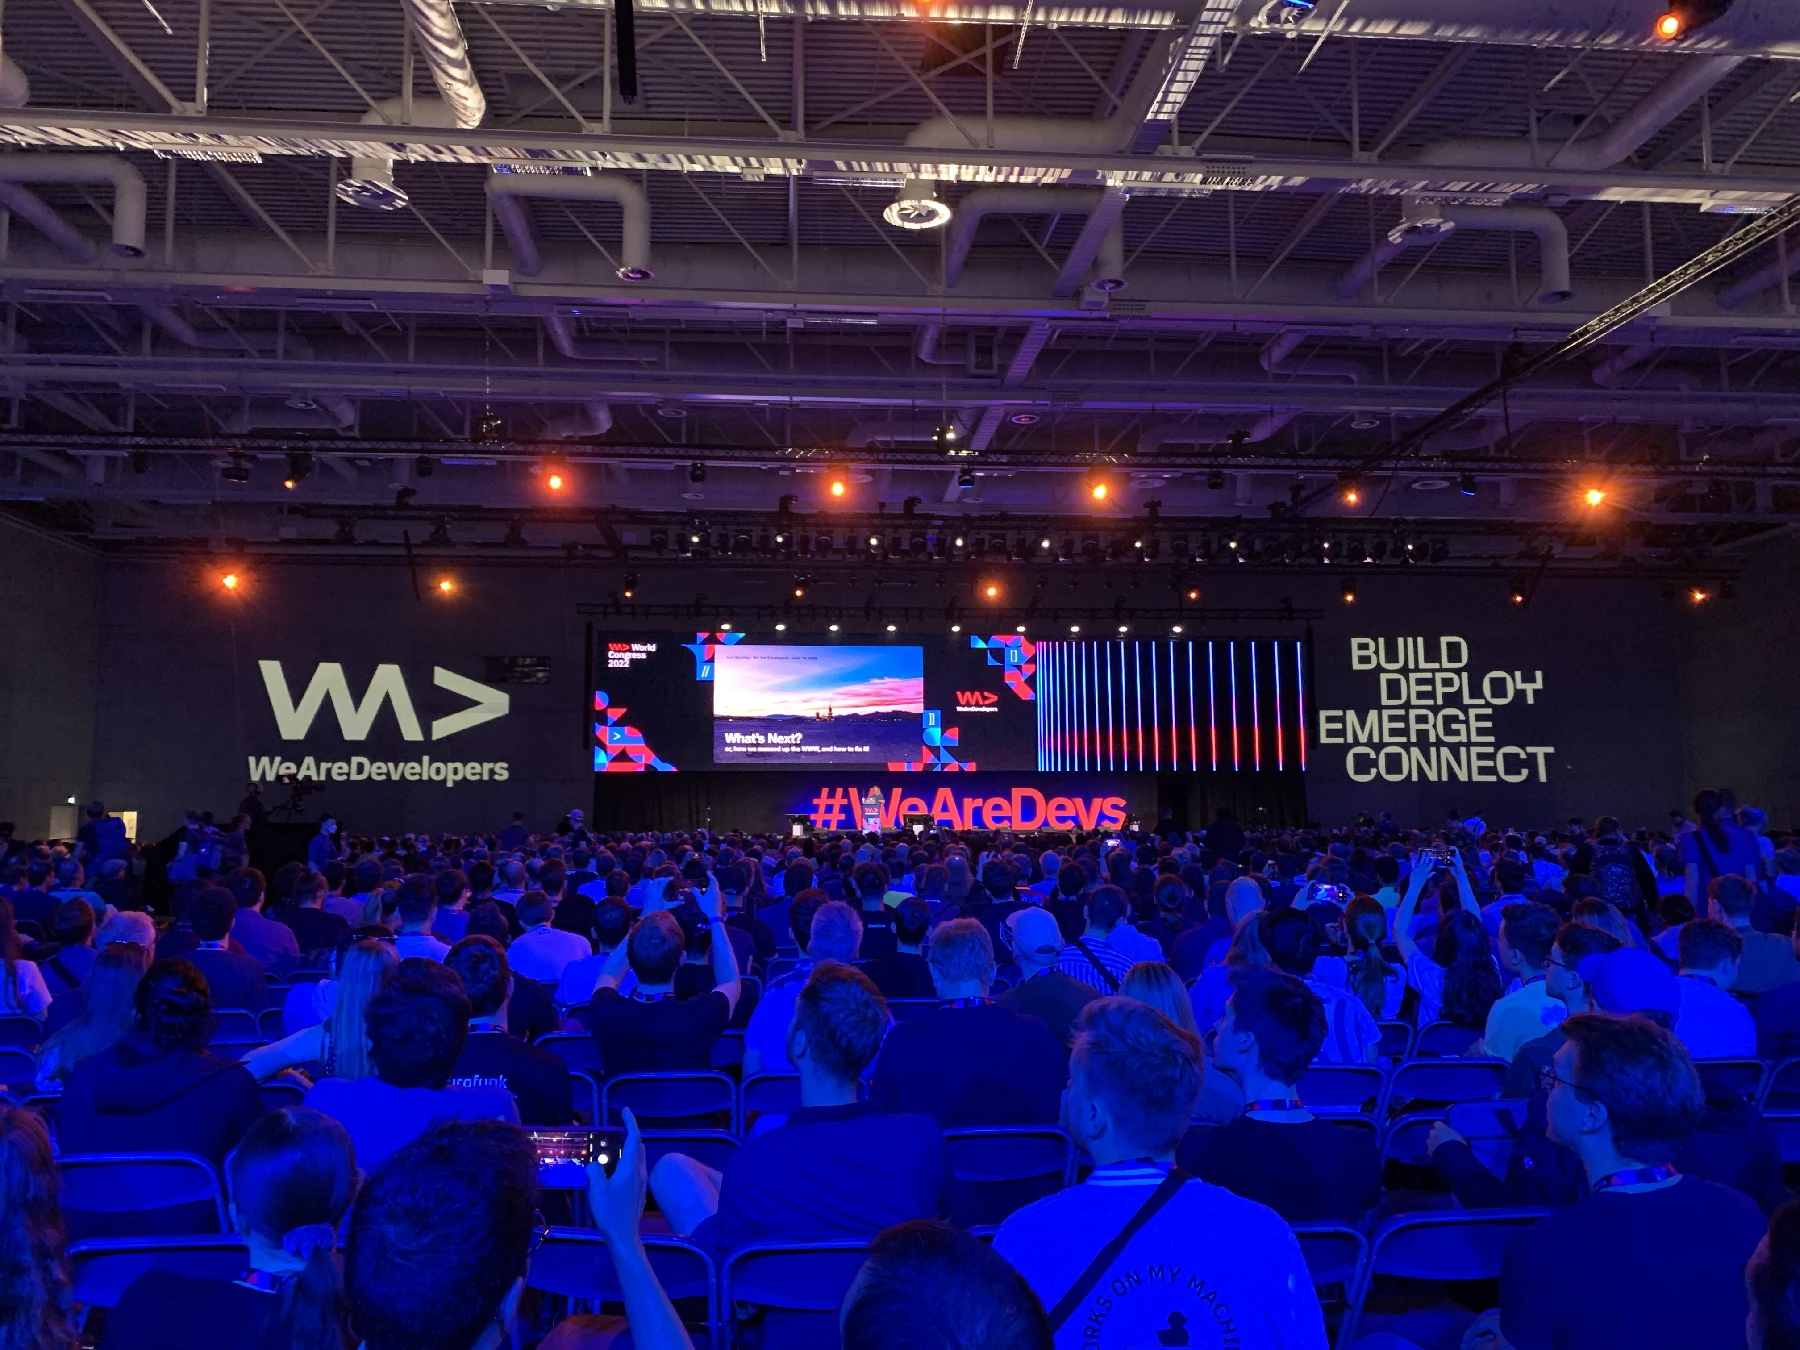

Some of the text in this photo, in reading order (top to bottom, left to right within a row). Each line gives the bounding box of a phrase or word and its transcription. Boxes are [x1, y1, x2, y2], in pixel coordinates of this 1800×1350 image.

[607, 651, 647, 660] Congress
[607, 660, 630, 668] 2022
[631, 643, 656, 651] World
[1351, 636, 1469, 670] BUILD
[1379, 670, 1543, 705] DEPLOY
[724, 732, 803, 744] What's Next?
[1319, 708, 1496, 743] EMERGE
[248, 755, 510, 787] WeAreDevelopers
[1345, 746, 1555, 783] CONNECT
[809, 786, 1127, 831] #WeAreDevs
[1110, 1268, 1143, 1297] ON
[1148, 1264, 1182, 1284] MY
[1186, 1274, 1241, 1350] MACHI
